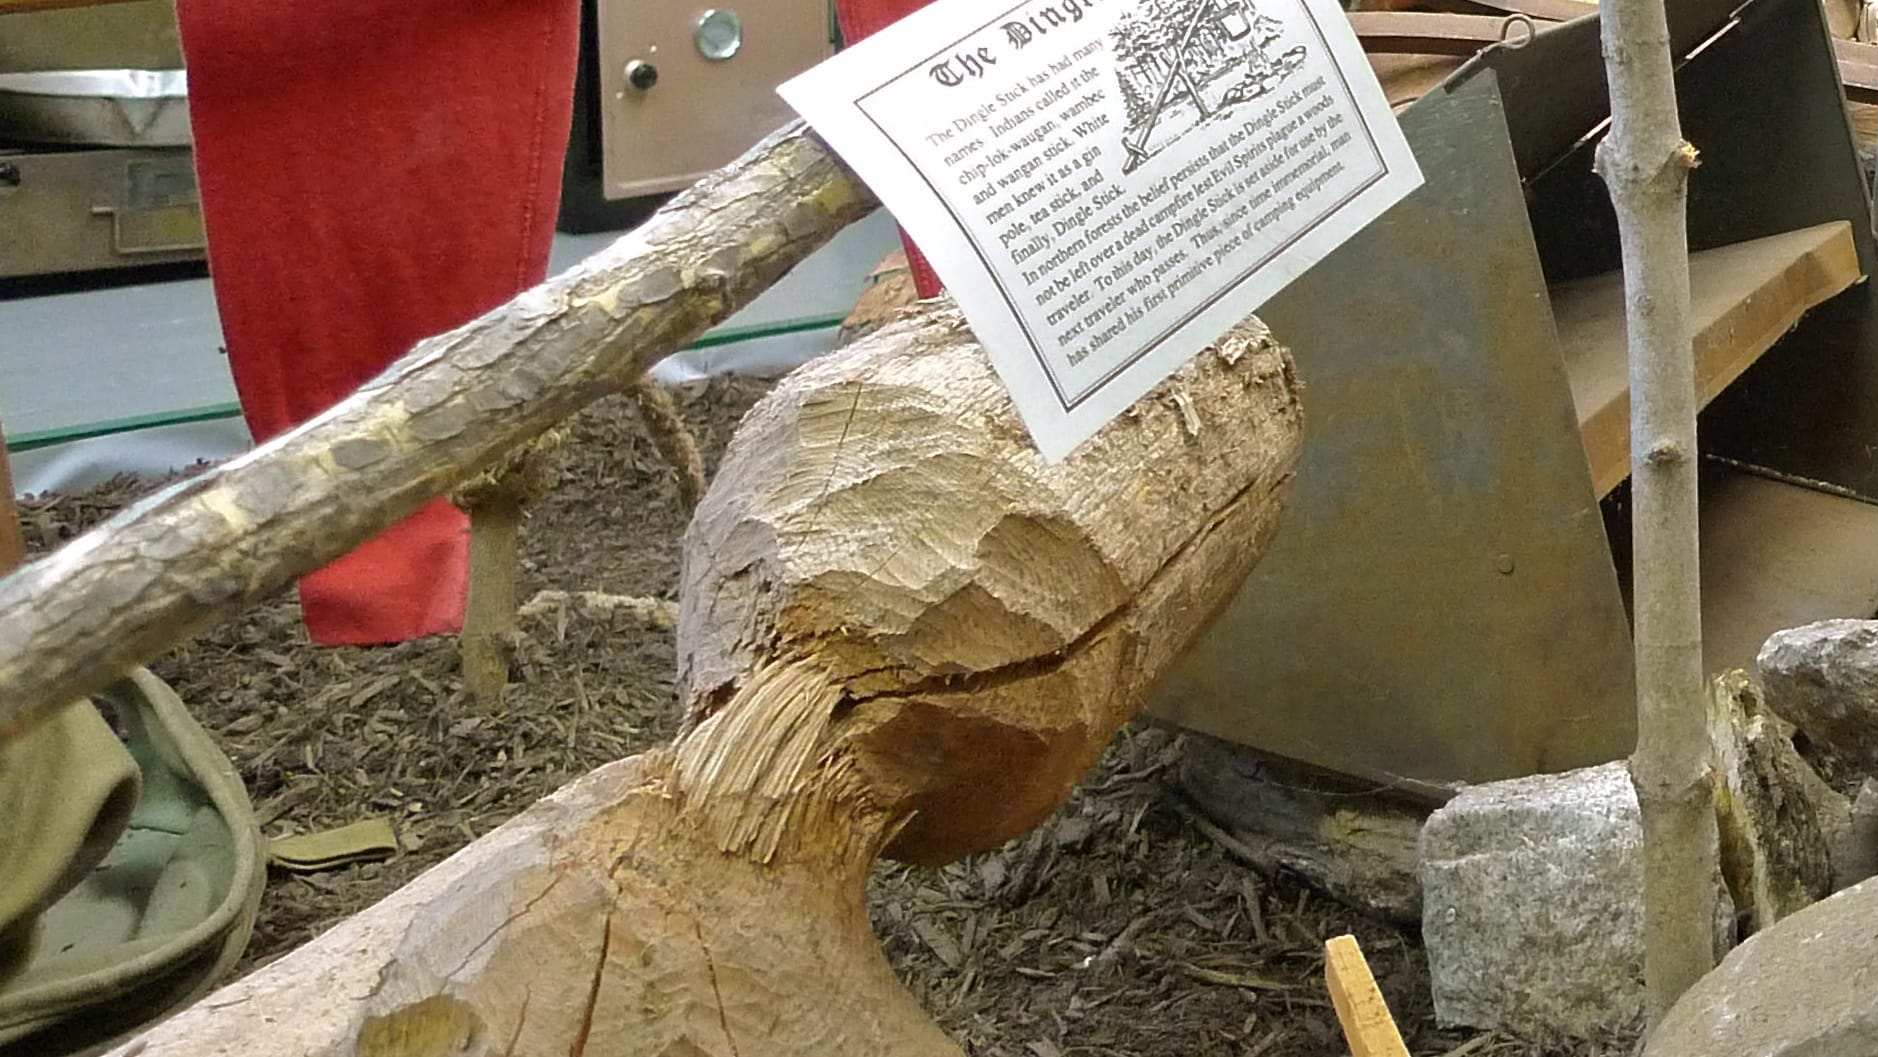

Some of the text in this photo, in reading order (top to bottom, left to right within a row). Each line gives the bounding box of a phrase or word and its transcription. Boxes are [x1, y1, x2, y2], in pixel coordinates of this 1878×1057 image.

[926, 38, 1103, 147] The Dingle Stick has had many
[928, 46, 998, 88] The
[988, 107, 1035, 138] Indians
[1035, 82, 1071, 110] called
[1070, 77, 1081, 90] it
[1080, 67, 1100, 83] the
[973, 182, 997, 205] and
[1072, 114, 1110, 138] White
[985, 146, 1102, 225] men knew it as a gin
[998, 219, 1032, 249] pole,
[1029, 207, 1051, 228] tea
[1080, 168, 1104, 195] and
[1021, 75, 1326, 287] In northern forests the belief persists that the Dingle Stick must
[1035, 94, 1334, 307] not be left over a dead campfire lest Evil Spirits plague a woods
[1092, 270, 1116, 295] To
[1108, 256, 1137, 284] this
[1128, 241, 1158, 270] day,
[1155, 228, 1177, 250] the
[1169, 203, 1212, 241] Dingle
[1205, 185, 1238, 217] Stick
[1231, 178, 1248, 198] is
[1241, 169, 1261, 189] set
[1259, 150, 1285, 181] aside
[1280, 142, 1300, 160] for
[1298, 132, 1316, 150] use
[1312, 120, 1328, 139] by
[1326, 111, 1344, 130] the
[1051, 202, 1094, 241] Dingle
[1056, 319, 1088, 347] next
[1080, 288, 1131, 332] traveler
[1125, 270, 1155, 301] who
[1221, 202, 1249, 230] since
[1248, 184, 1275, 210] time
[1327, 132, 1352, 152] man
[1066, 345, 1090, 367] has
[1088, 316, 1127, 352] shared
[1123, 305, 1144, 325] his
[1140, 286, 1168, 312] first
[1163, 256, 1215, 299] primitive
[1210, 232, 1245, 266] piece
[1238, 222, 1254, 240] of
[1250, 196, 1296, 233] camping
